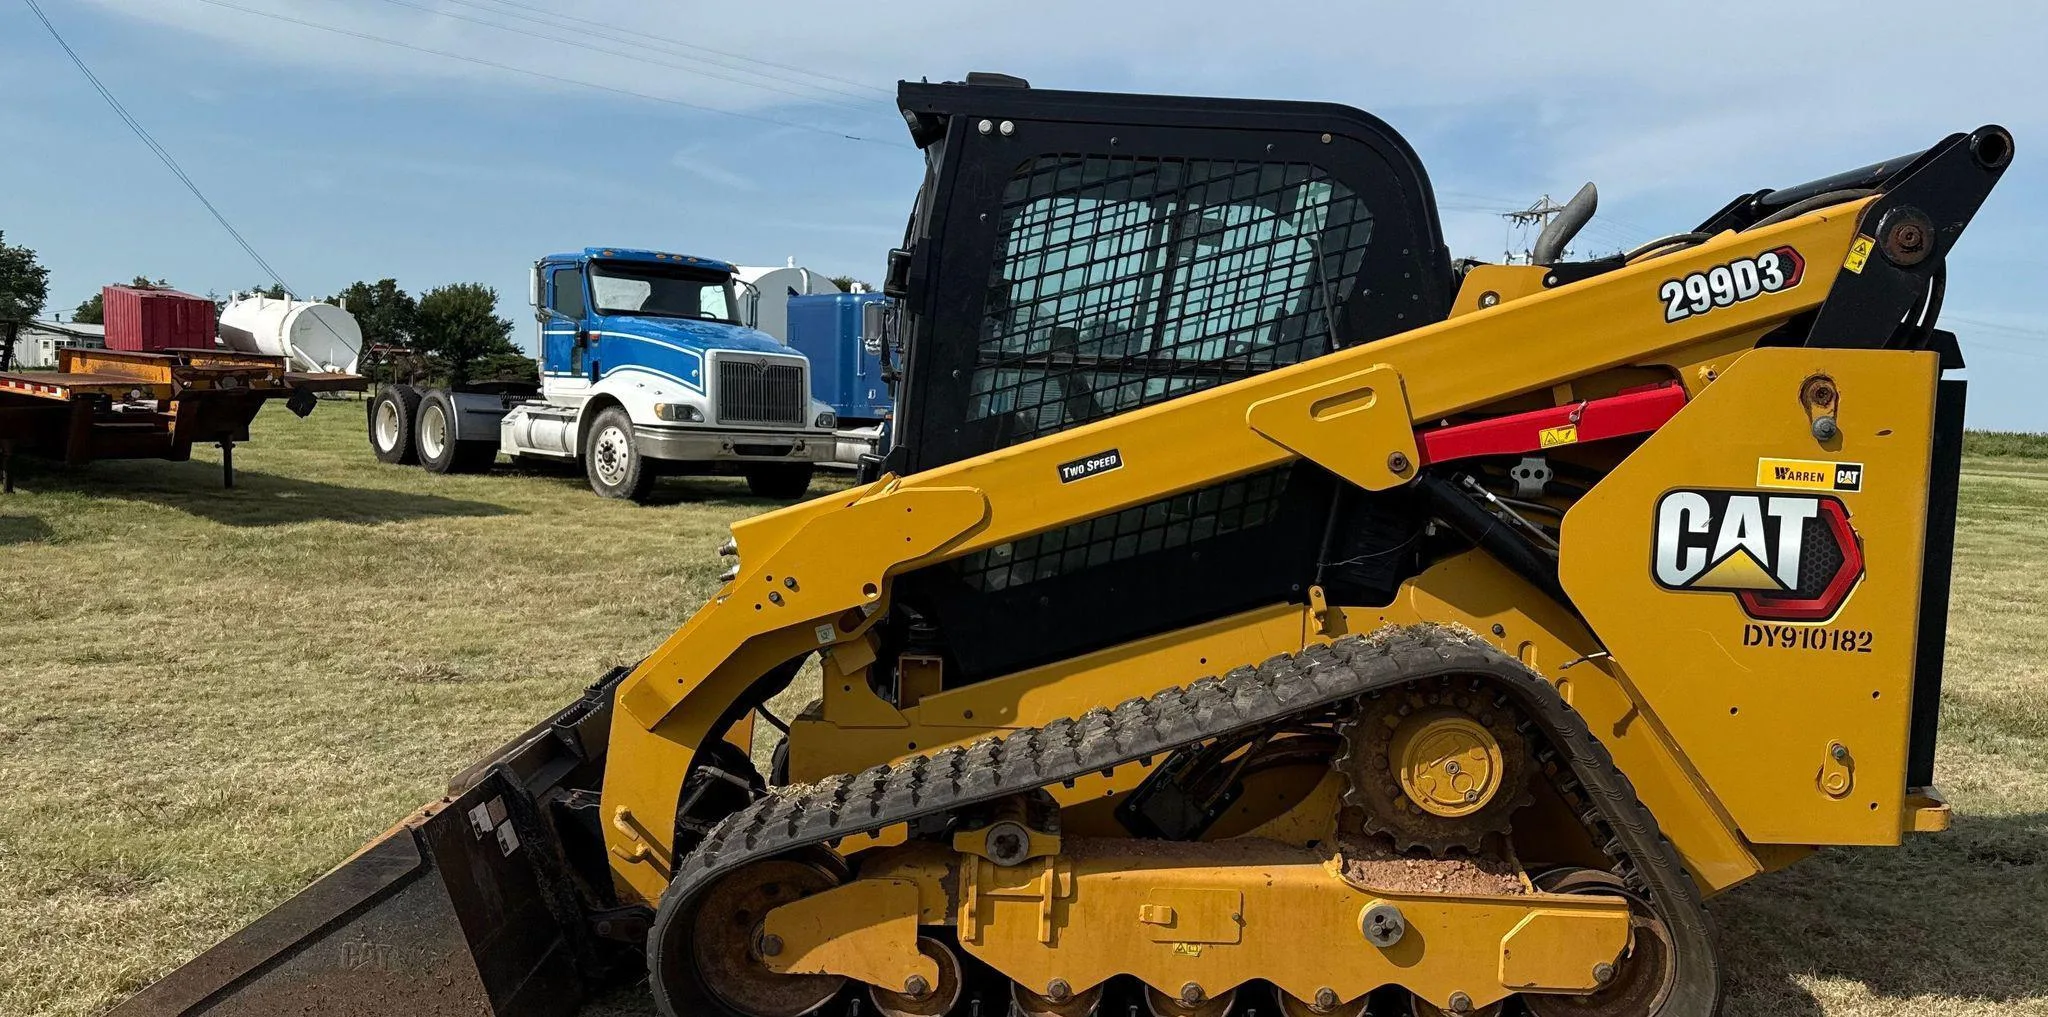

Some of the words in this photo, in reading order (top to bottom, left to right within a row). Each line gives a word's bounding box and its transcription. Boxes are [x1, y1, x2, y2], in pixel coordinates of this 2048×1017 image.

[1660, 251, 1784, 321] 299D3
[1063, 464, 1085, 478] TWO
[1086, 455, 1116, 471] SPEED
[1774, 466, 1825, 482] WARREN
[1836, 470, 1859, 485] CAT
[1656, 491, 1819, 591] CAT
[1743, 624, 1873, 653] DY910182
